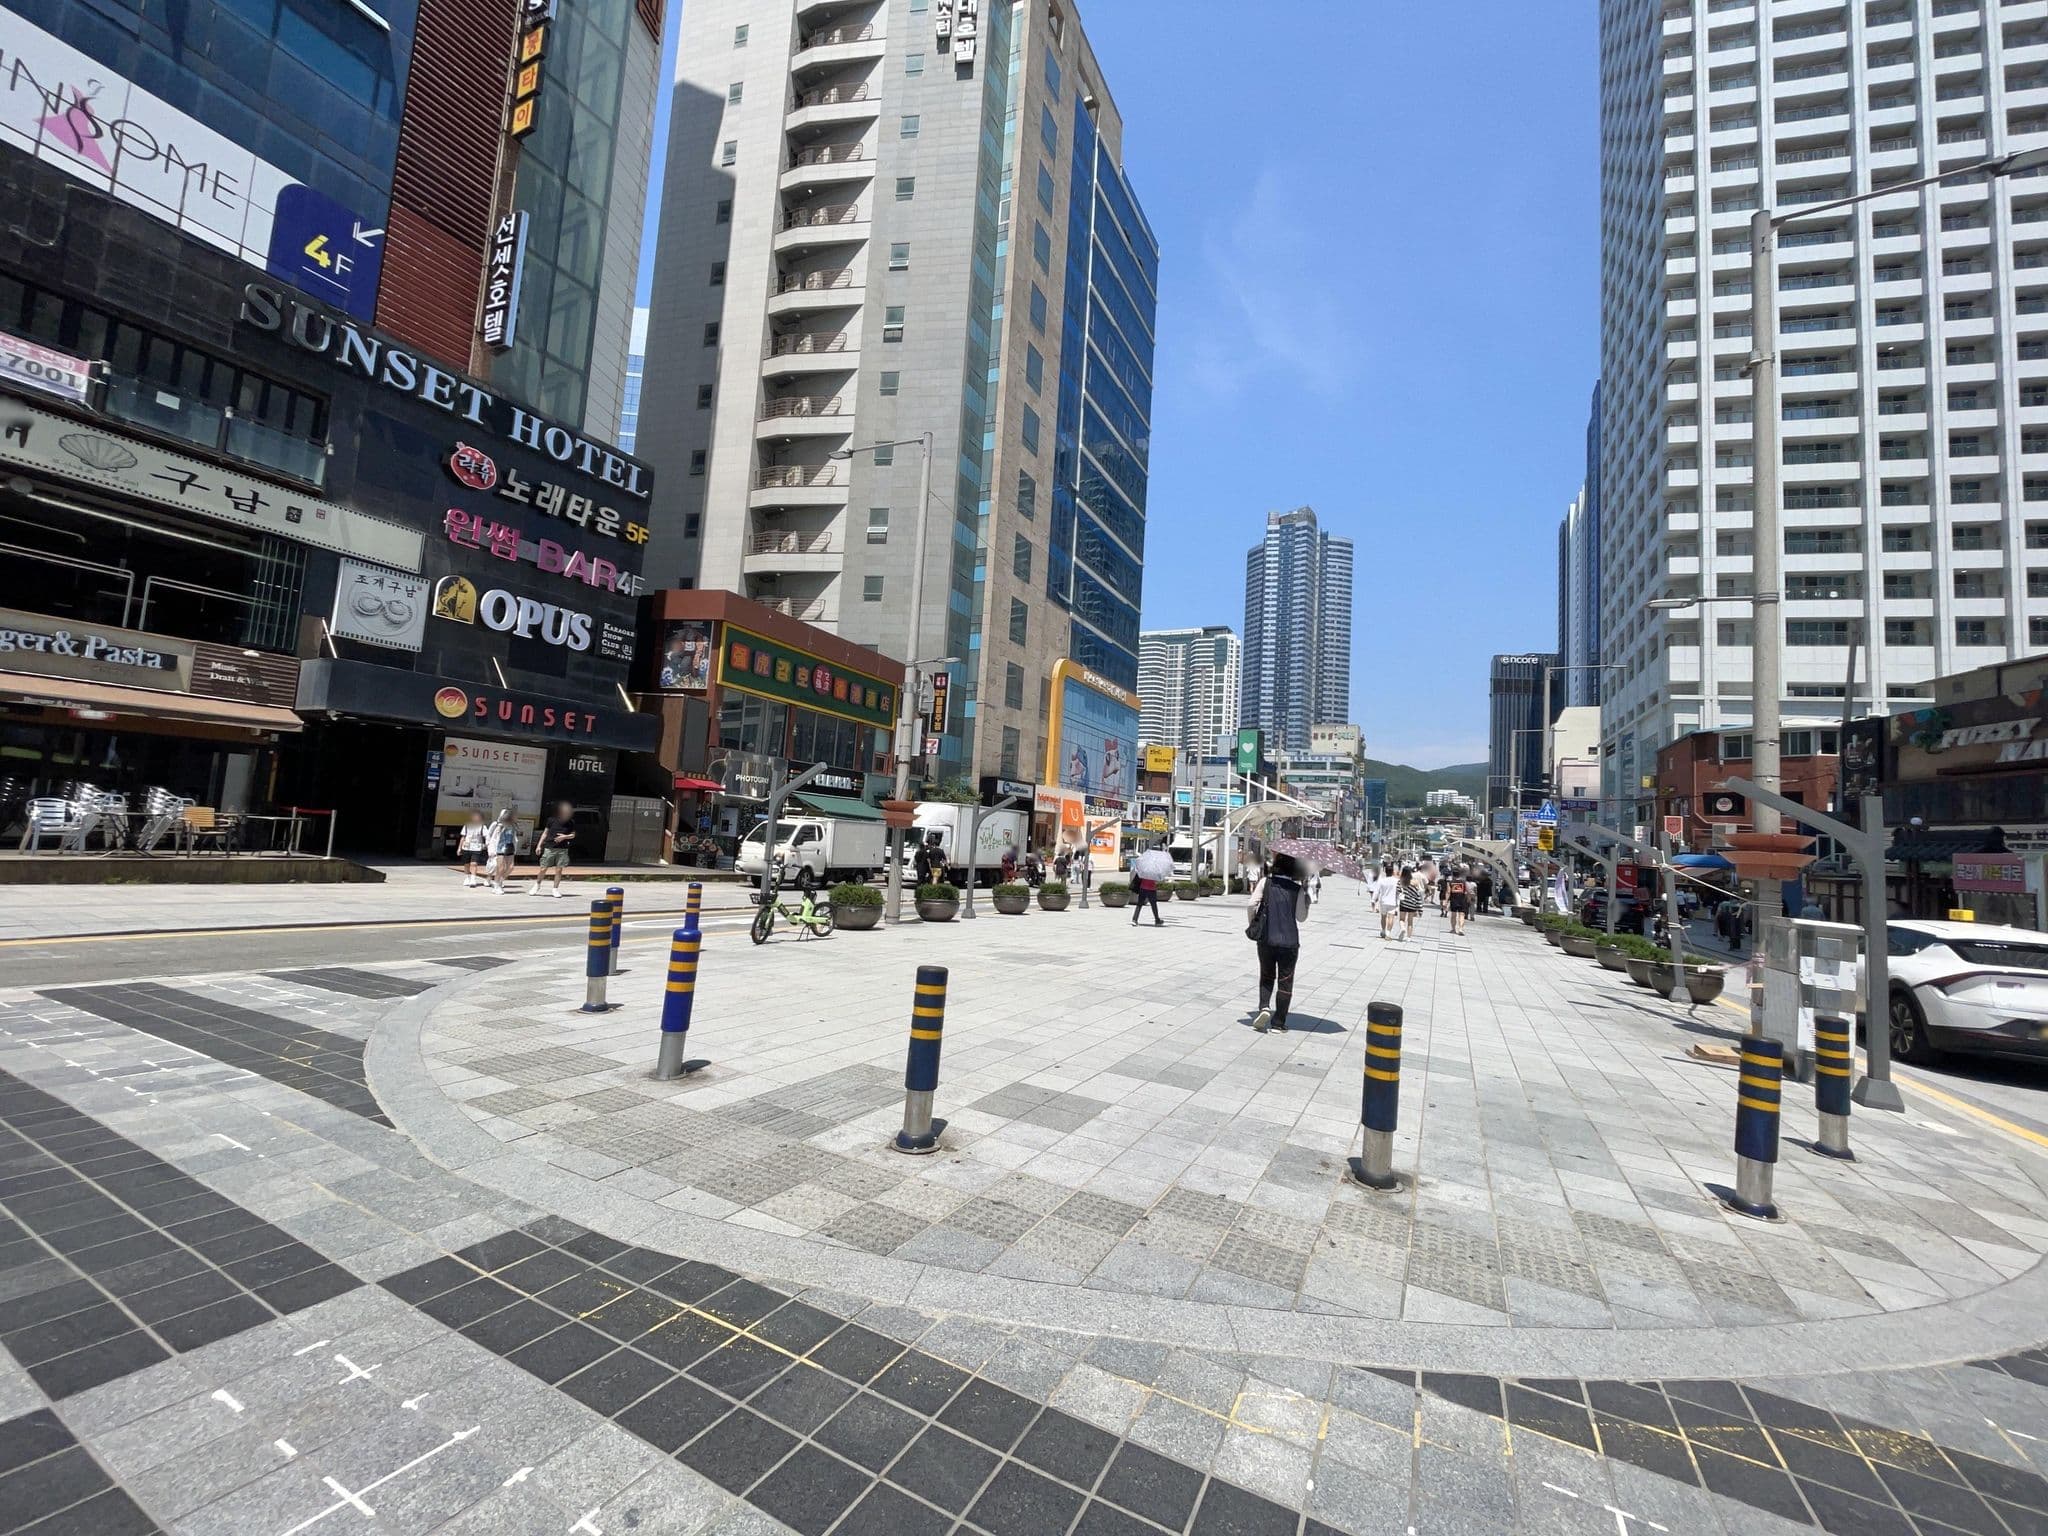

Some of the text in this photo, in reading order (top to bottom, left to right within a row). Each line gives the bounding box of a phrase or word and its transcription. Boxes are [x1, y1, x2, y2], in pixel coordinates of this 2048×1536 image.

[240, 283, 649, 498] SUNSET HOTEL
[500, 468, 620, 537] 노래타운
[625, 521, 650, 545] 5F
[537, 538, 617, 592] BAR
[354, 574, 417, 598] 조개구남
[480, 589, 593, 652] OPUS
[81, 634, 162, 669] Pasta
[474, 697, 596, 732] SUNSET
[1938, 717, 2042, 748] FUZZY
[462, 746, 520, 763] SUNSET
[568, 758, 605, 773] HOTEL
